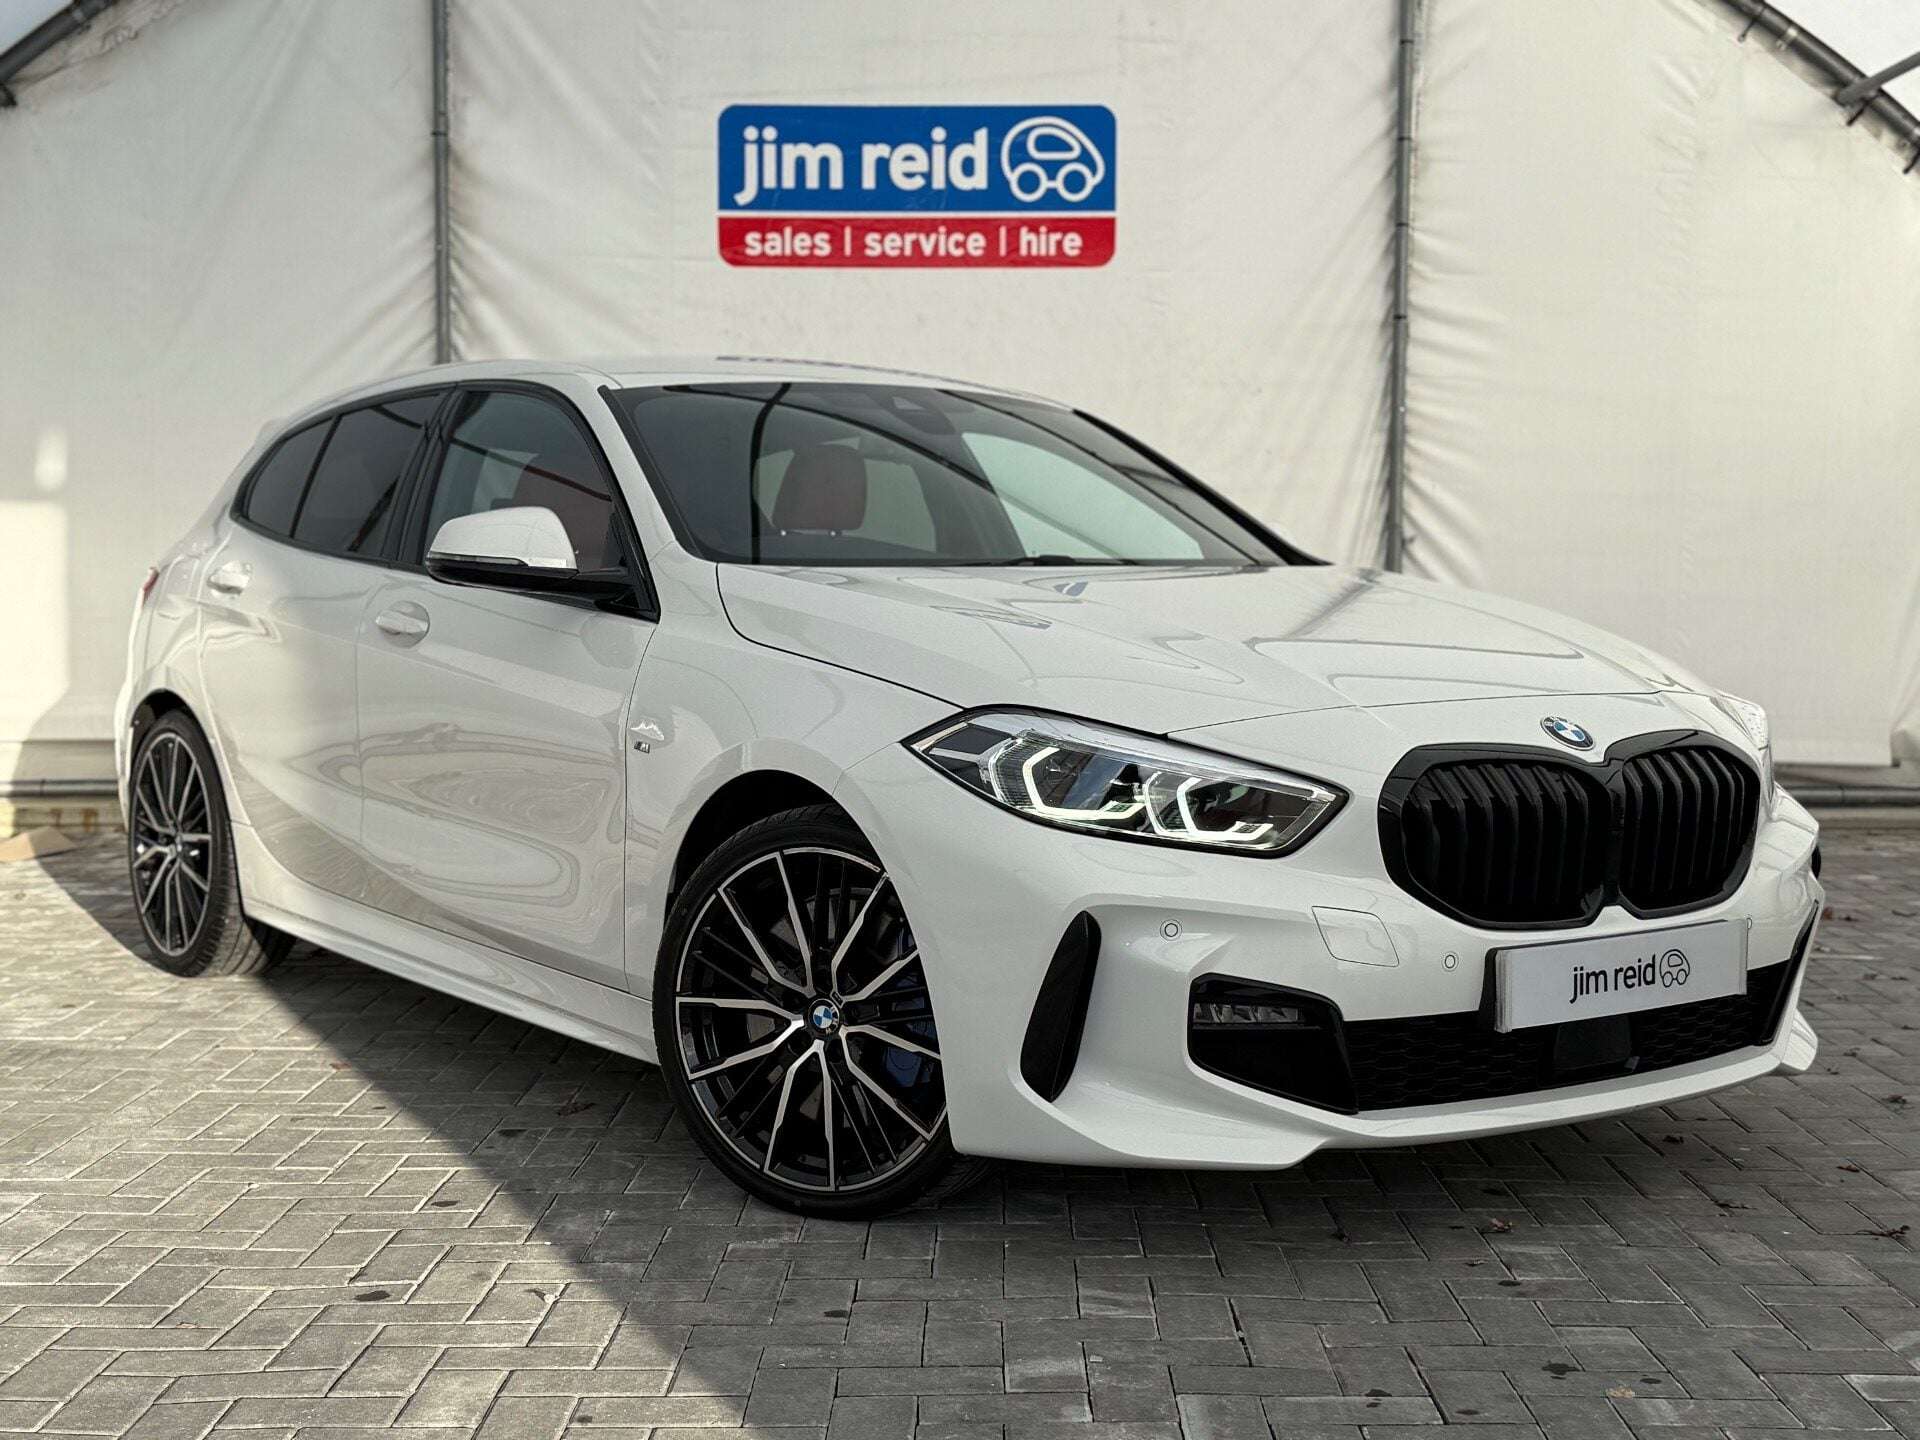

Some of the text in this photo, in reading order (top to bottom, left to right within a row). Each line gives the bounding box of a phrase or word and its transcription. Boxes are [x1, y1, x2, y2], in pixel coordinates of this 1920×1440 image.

[733, 125, 988, 206] jim reid
[744, 225, 1083, 257] sales service hire
[1569, 953, 1656, 1004] jim reid
